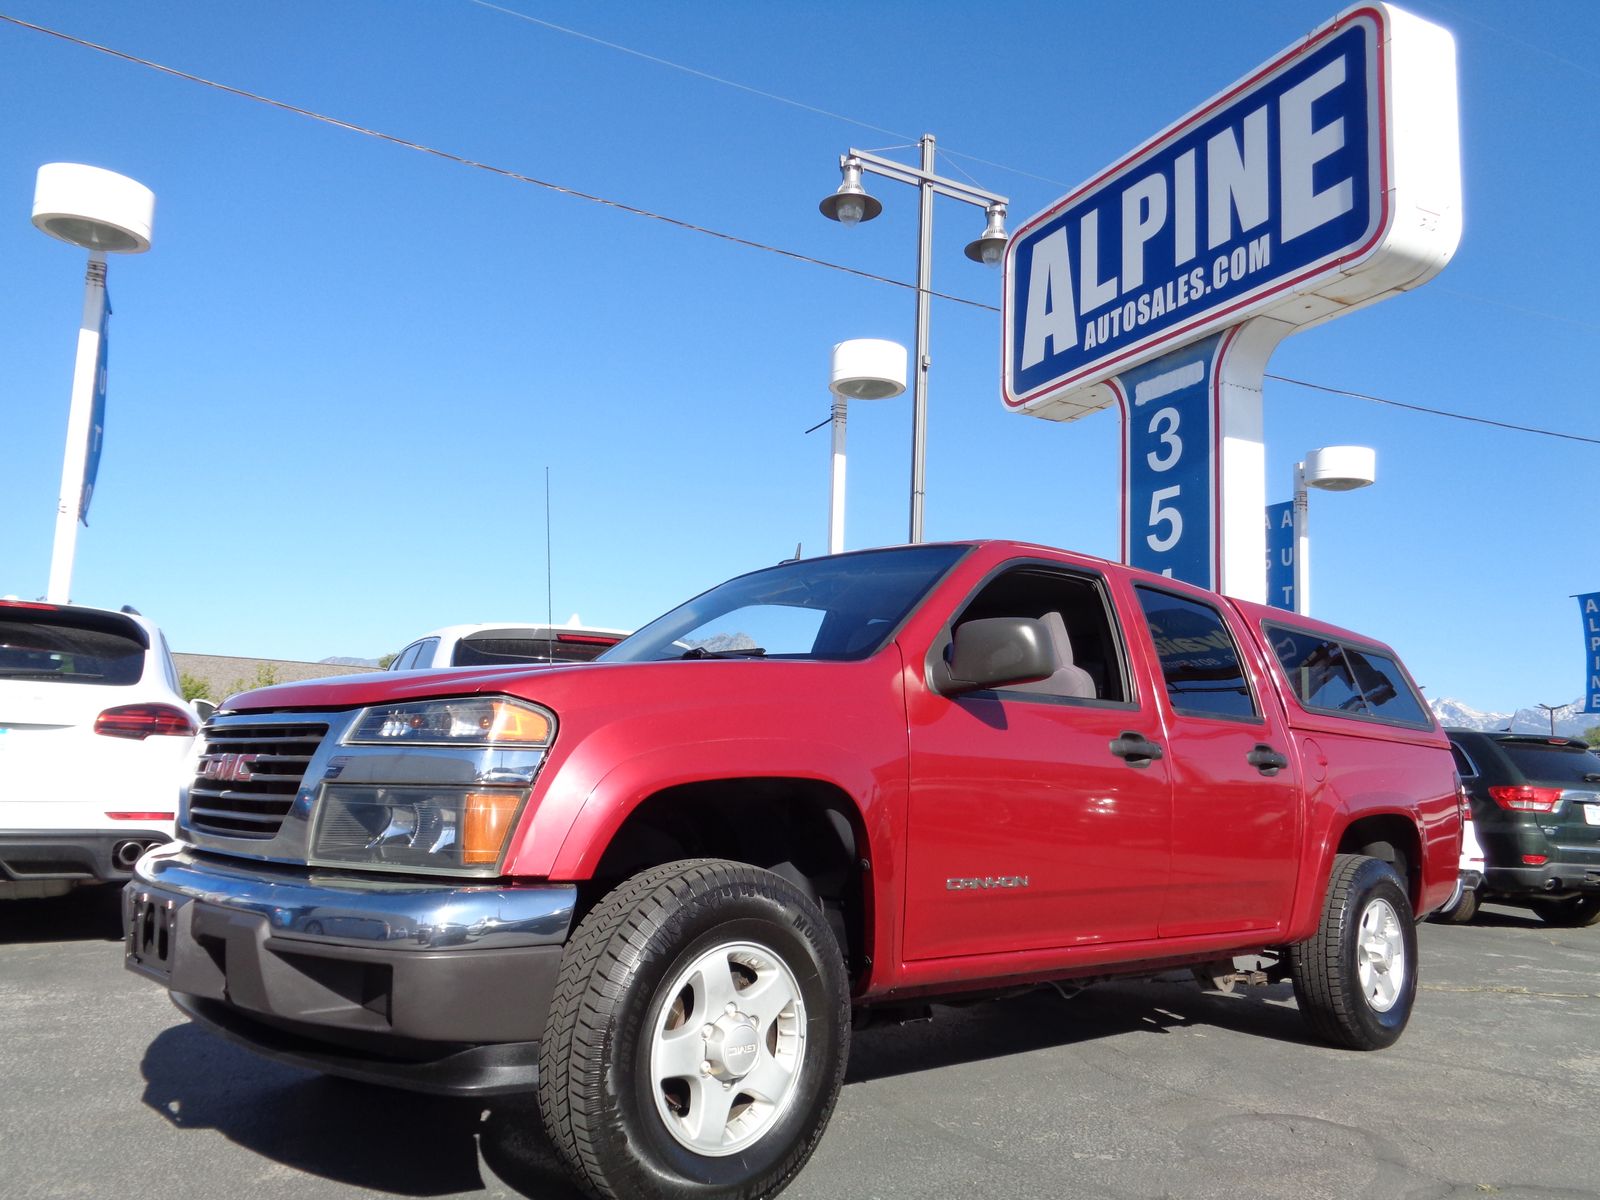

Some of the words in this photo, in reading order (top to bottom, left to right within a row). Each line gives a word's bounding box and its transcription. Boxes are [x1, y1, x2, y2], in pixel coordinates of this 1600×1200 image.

[1021, 53, 1353, 371] ALPINE
[1084, 233, 1270, 351] AUTOSALES.COM
[1586, 598, 1600, 708] ALPINE
[204, 753, 258, 782] GMC
[946, 876, 1028, 890] CANYON
[728, 1043, 756, 1057] GMC
